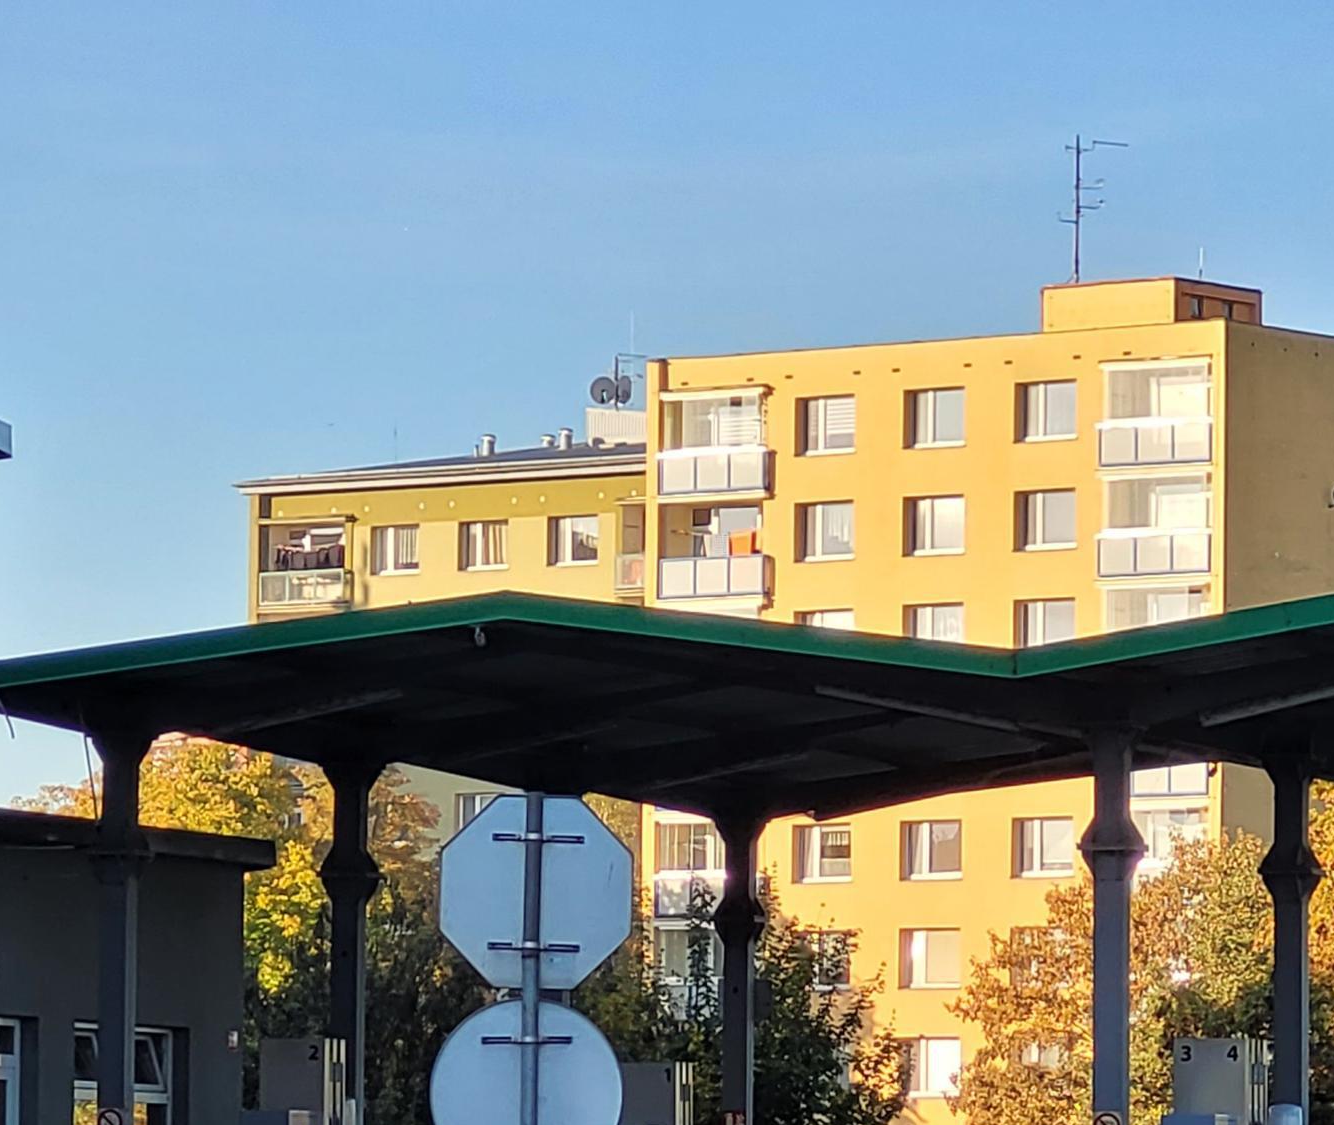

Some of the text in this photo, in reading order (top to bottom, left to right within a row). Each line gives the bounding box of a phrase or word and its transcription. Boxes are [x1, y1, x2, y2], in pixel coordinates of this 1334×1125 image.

[308, 1045, 319, 1060] 2
[1181, 1045, 1192, 1062] 3
[1226, 1045, 1239, 1062] 4
